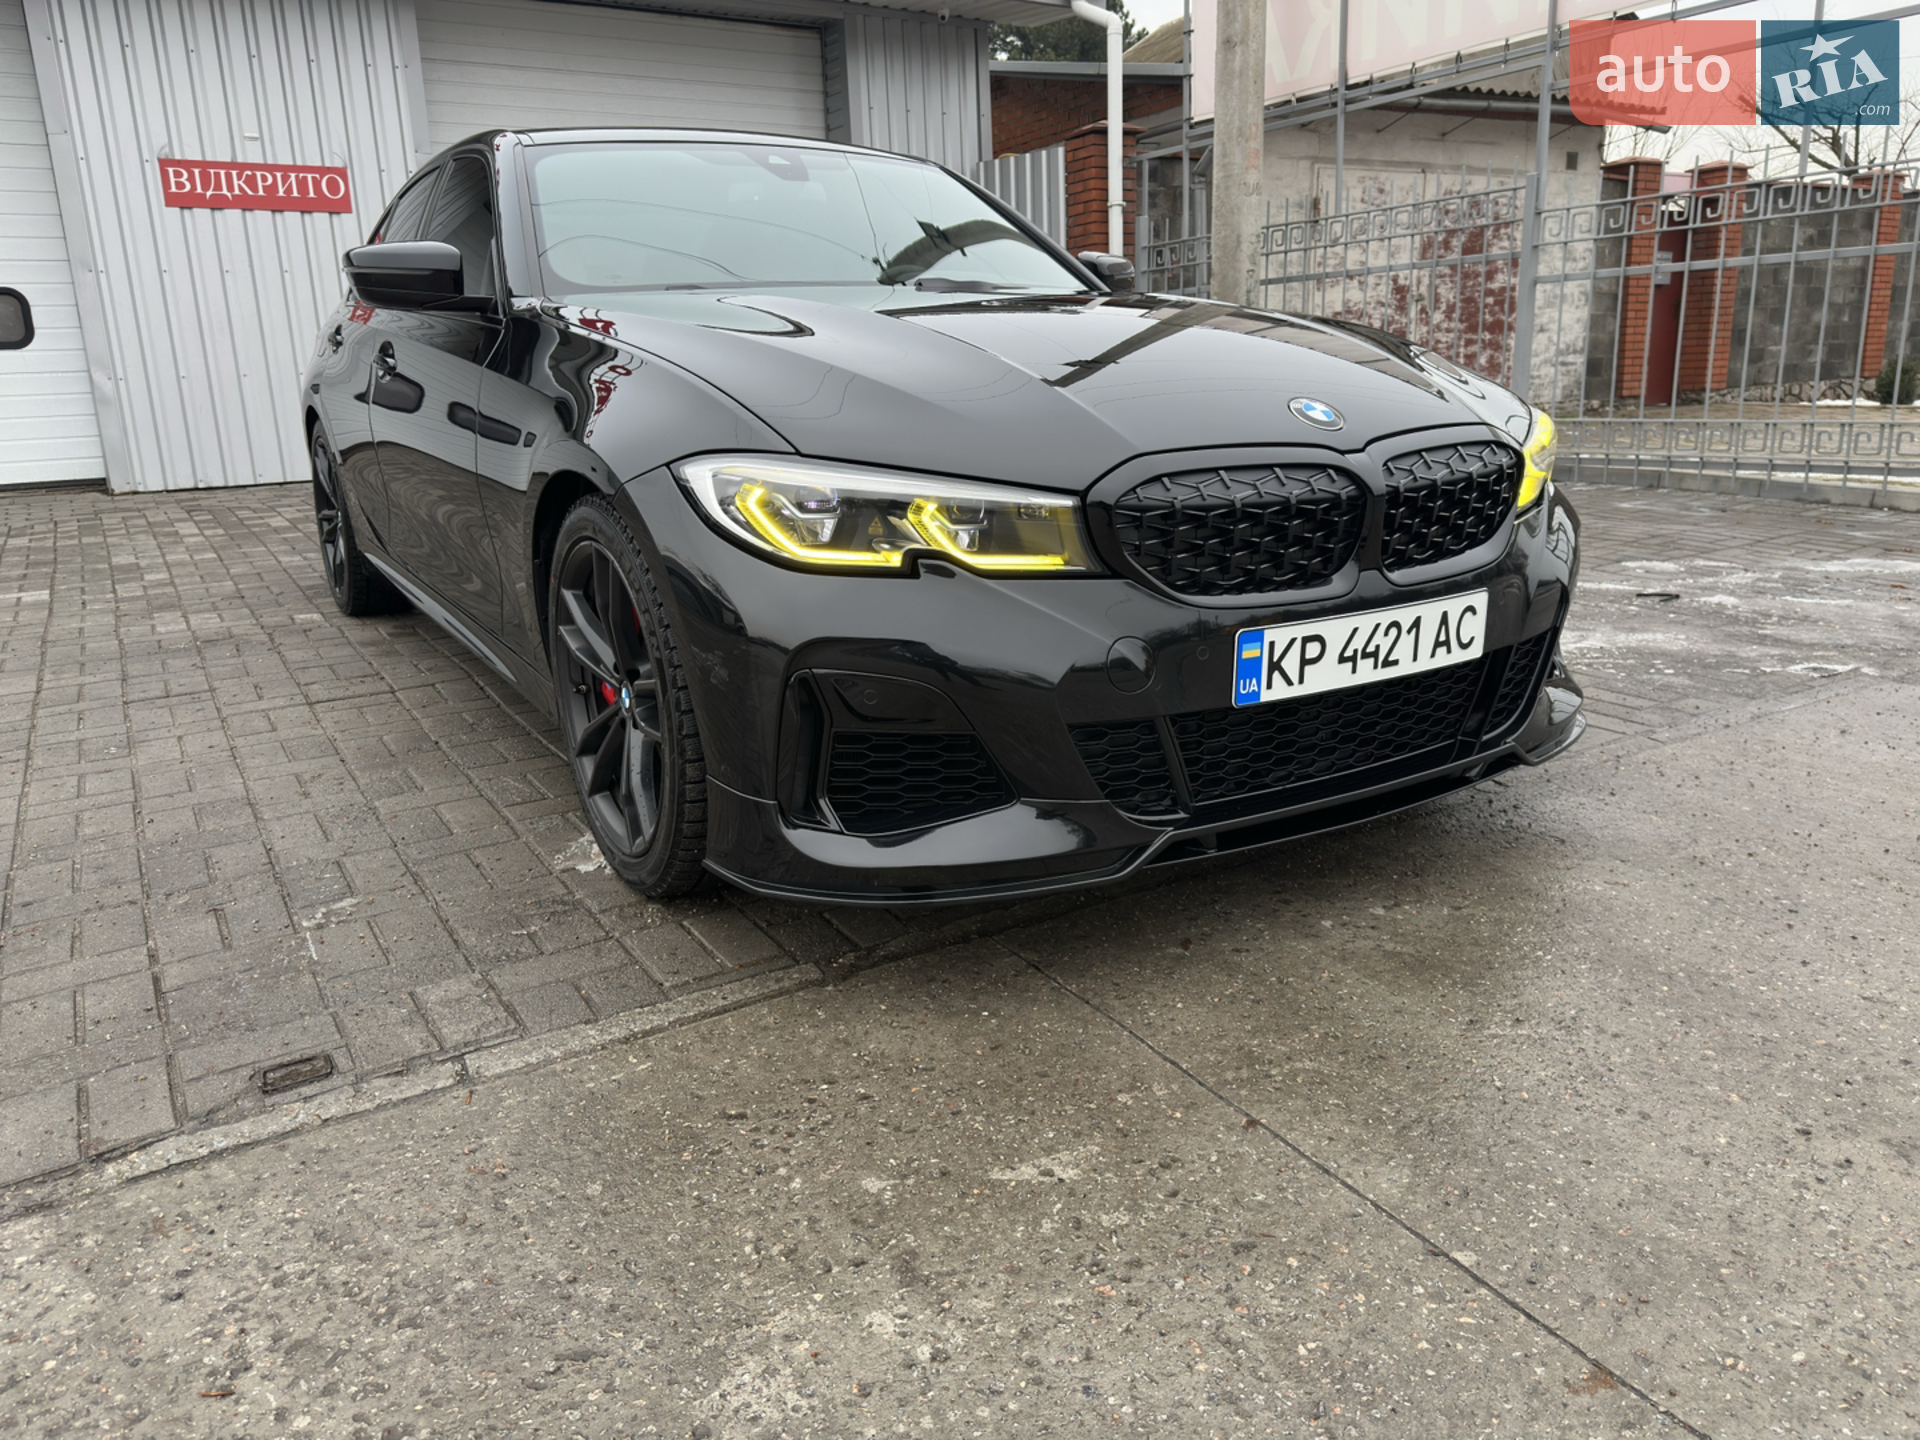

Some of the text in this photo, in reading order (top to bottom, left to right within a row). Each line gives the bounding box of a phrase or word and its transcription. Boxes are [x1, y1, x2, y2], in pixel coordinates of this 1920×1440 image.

[165, 167, 346, 201] ВІДКРИТО
[1266, 604, 1477, 690] KP 4421 AC
[1239, 677, 1259, 694] UA
